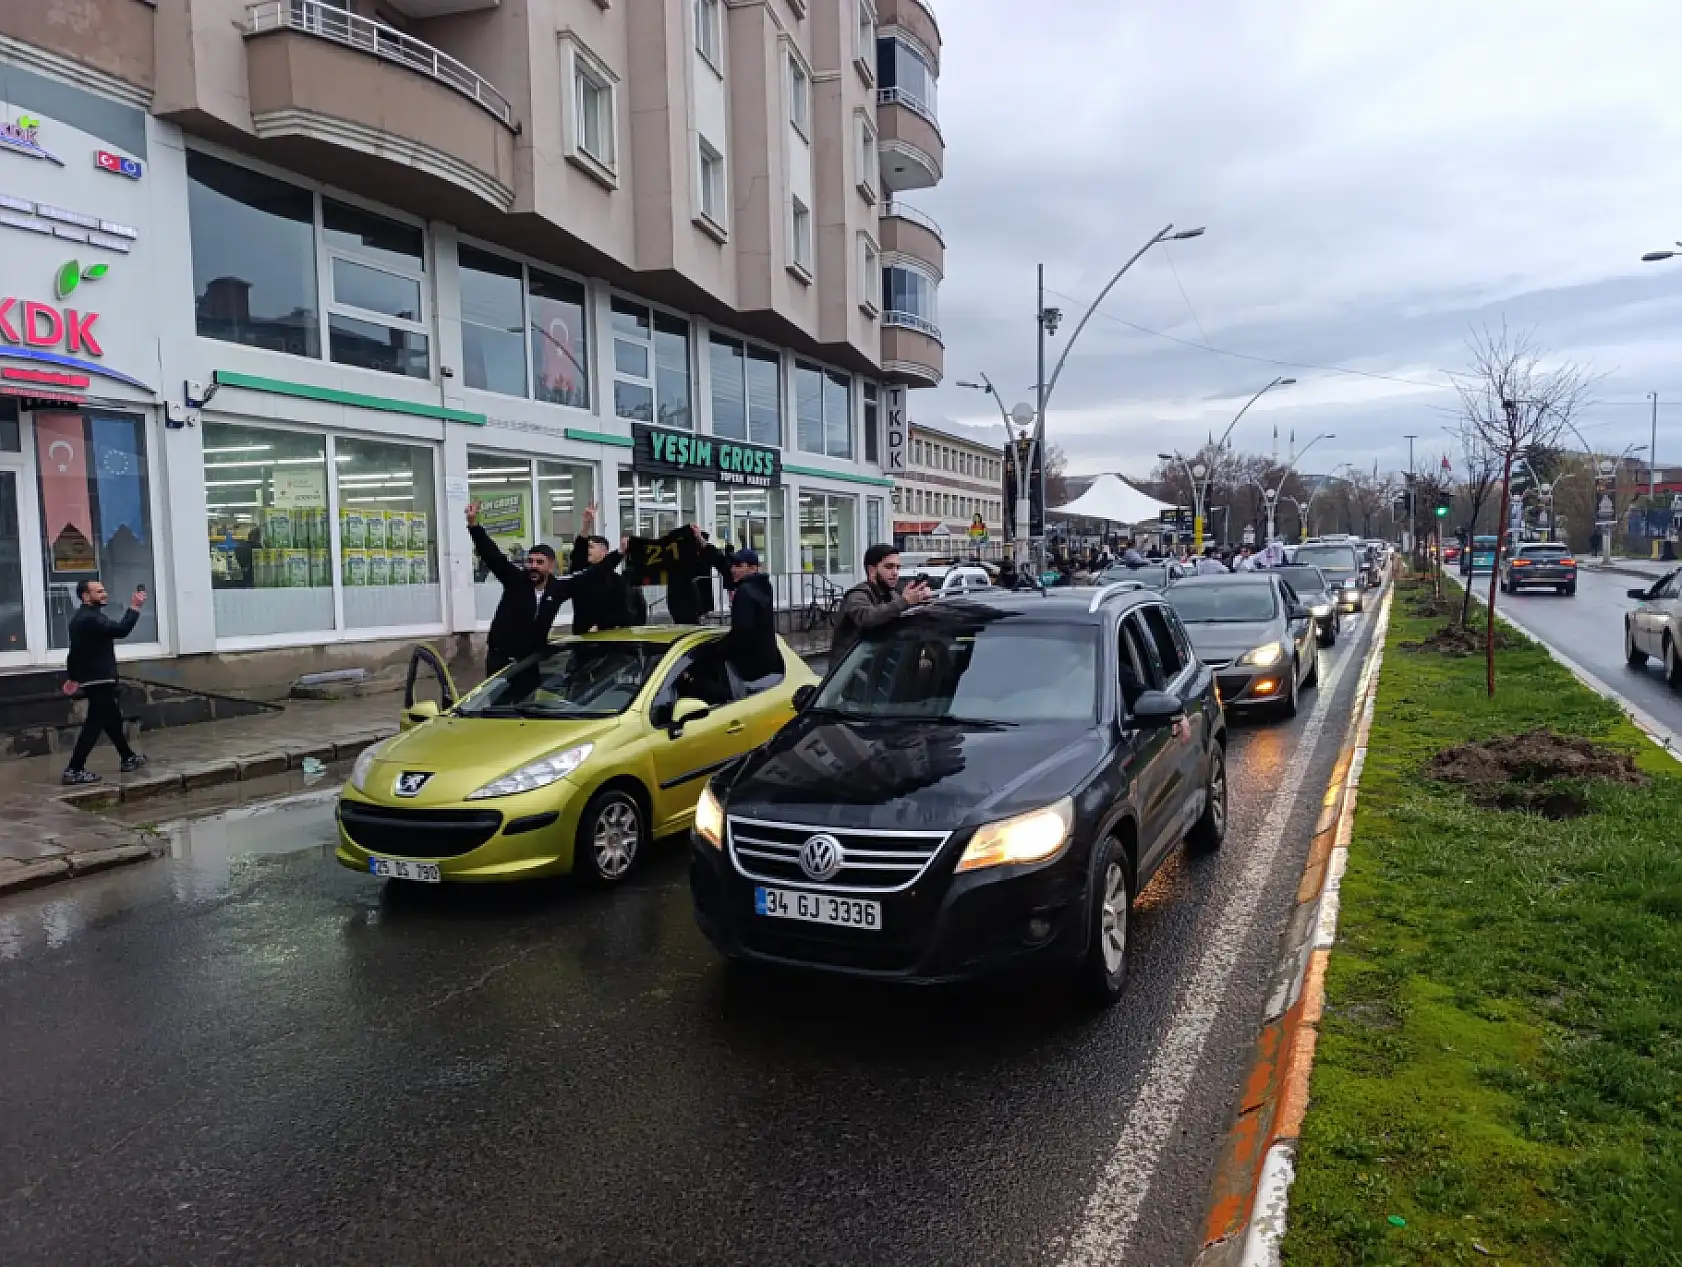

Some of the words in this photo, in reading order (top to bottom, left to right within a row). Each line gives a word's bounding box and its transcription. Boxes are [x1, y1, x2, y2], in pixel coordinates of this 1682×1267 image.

[888, 388, 903, 469] TKDK
[720, 444, 774, 476] GROSS
[642, 541, 680, 566] 21
[766, 890, 789, 915] 34
[797, 894, 820, 919] GJ
[828, 898, 876, 926] 3336
